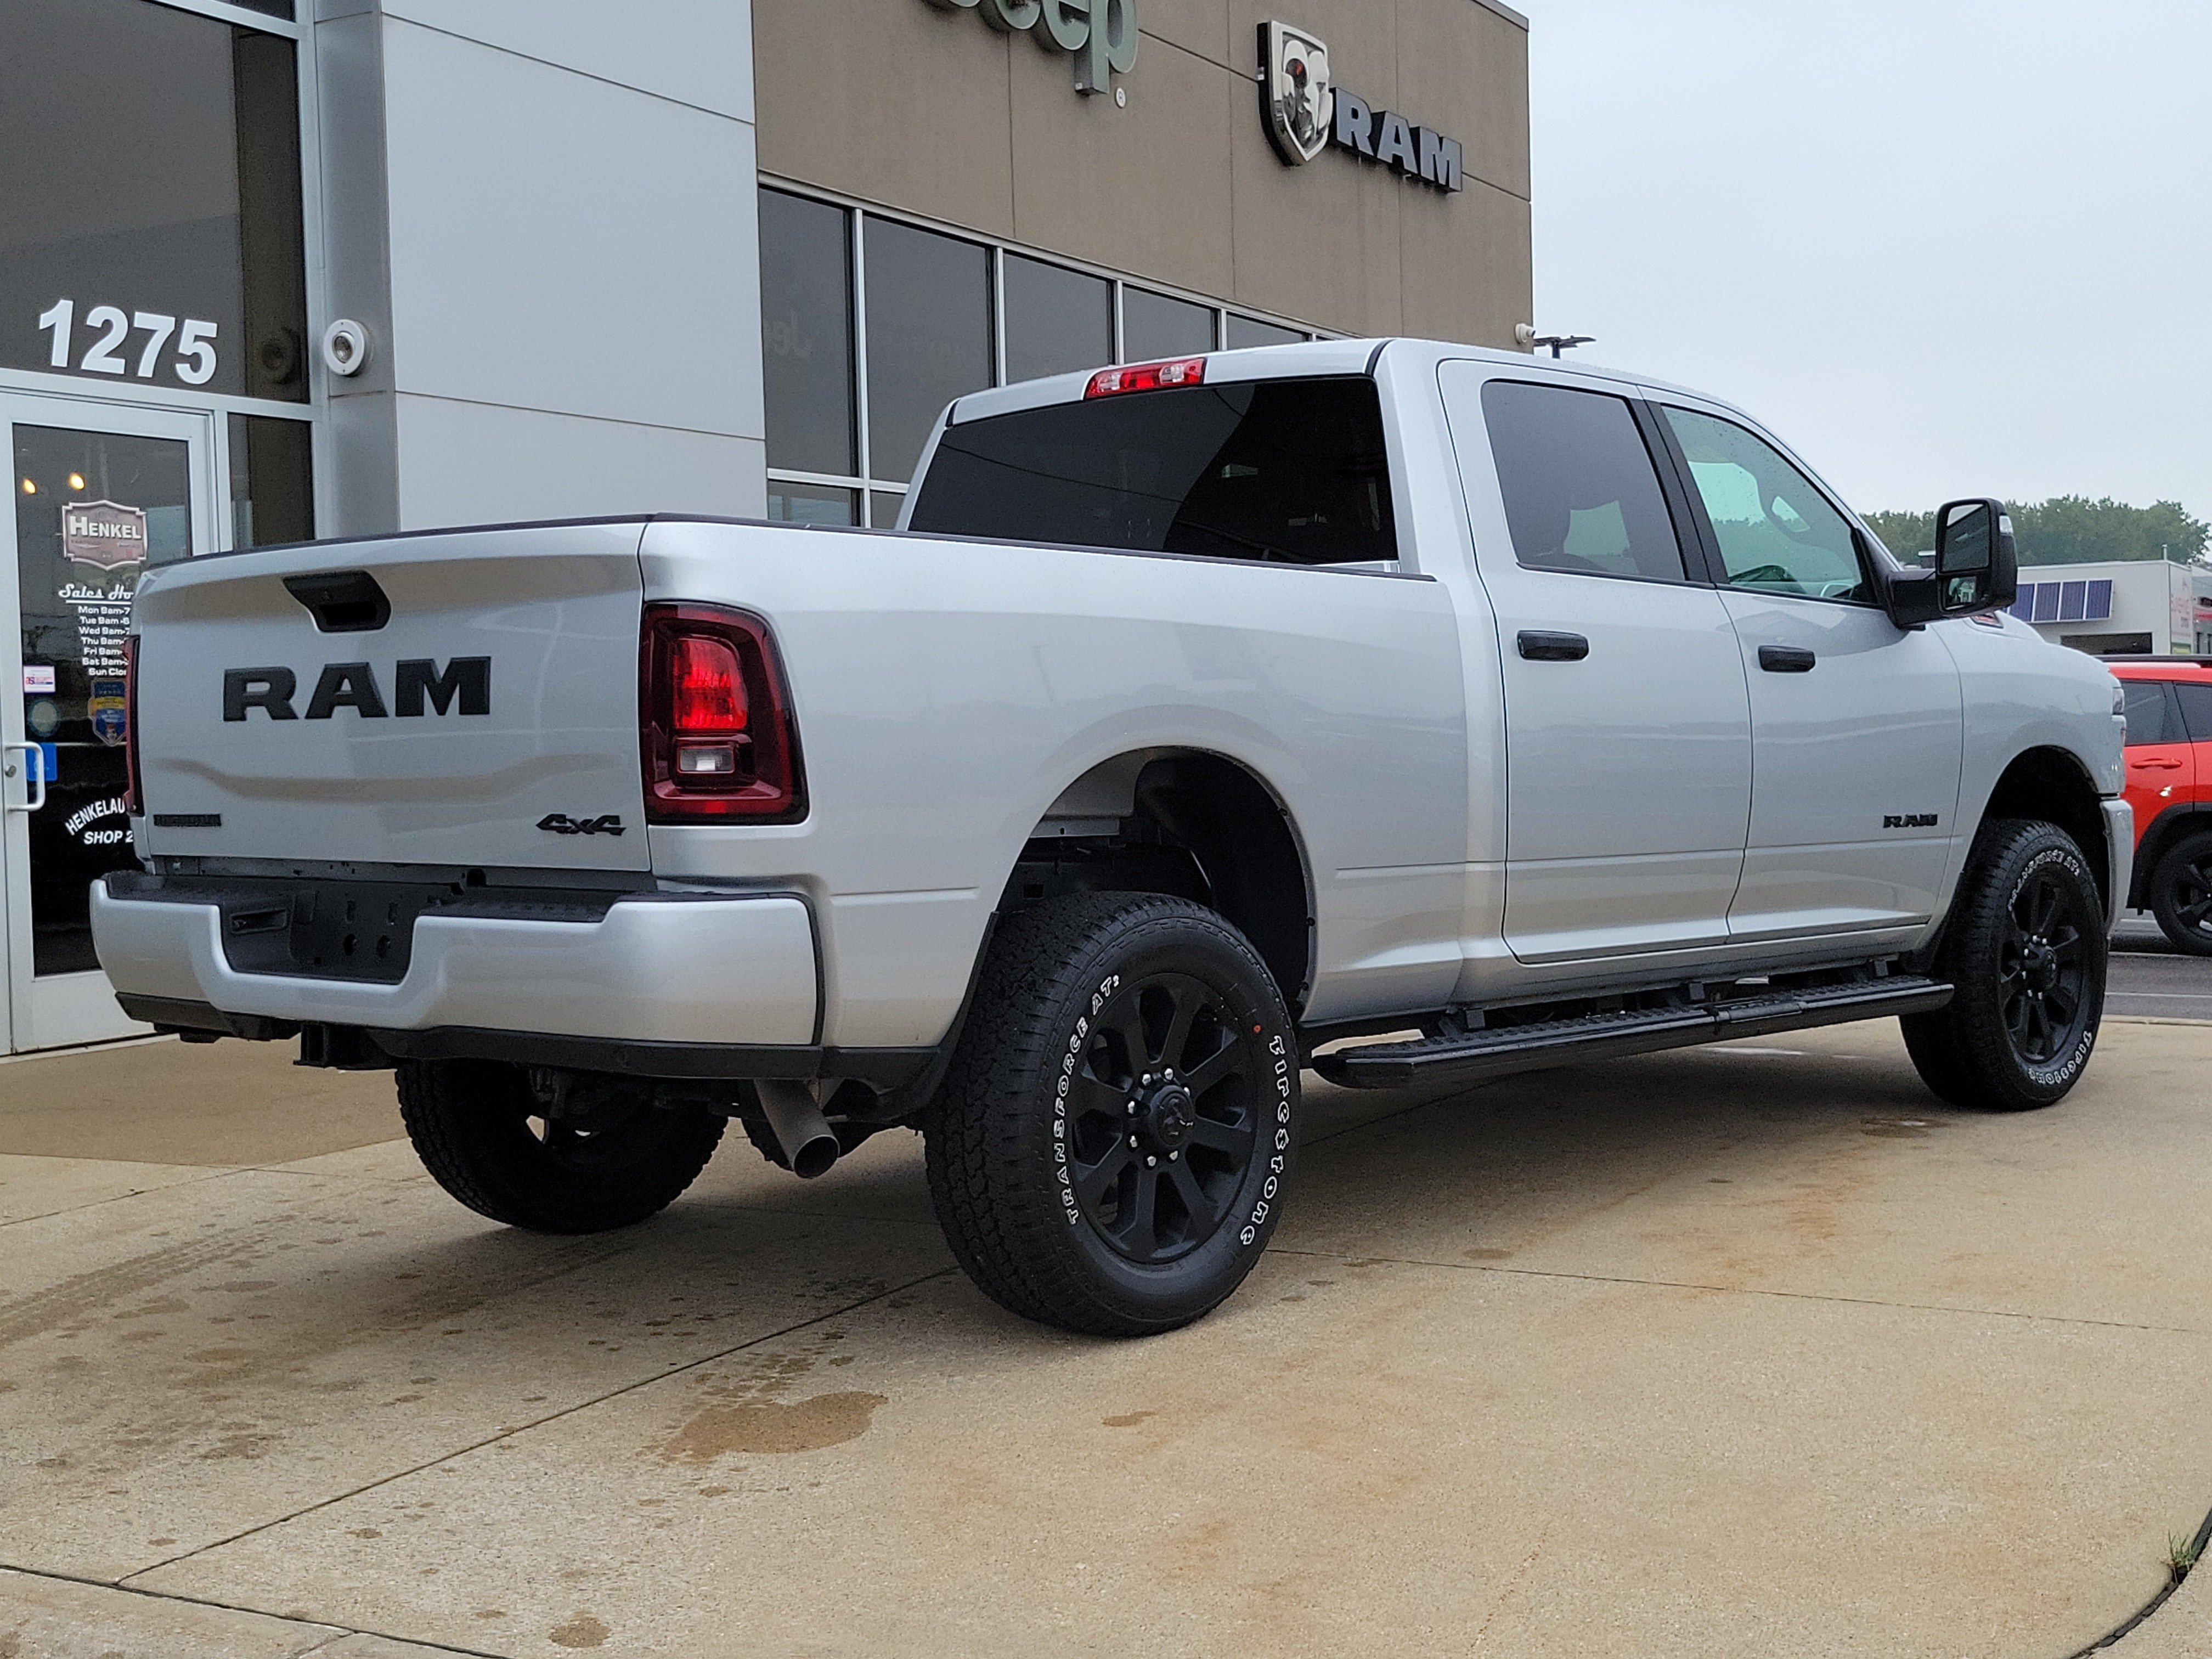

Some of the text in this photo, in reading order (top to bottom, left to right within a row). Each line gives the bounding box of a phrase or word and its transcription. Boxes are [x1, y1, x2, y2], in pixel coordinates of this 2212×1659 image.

[1333, 87, 1463, 192] RAM
[39, 299, 218, 384] 1275
[70, 516, 142, 539] HENKEL
[58, 583, 105, 599] Sales
[78, 606, 99, 614] Mon
[80, 616, 97, 624] Tue
[78, 627, 100, 635] Wed
[81, 636, 99, 645] Thu
[83, 647, 97, 656] Fri
[82, 657, 100, 665] Sat
[88, 668, 108, 676] Sun
[223, 656, 492, 722] RAM
[1882, 813, 1938, 828] RAM
[83, 830, 123, 845] SHOP
[1053, 1016, 1088, 1225] TRANSFORCE
